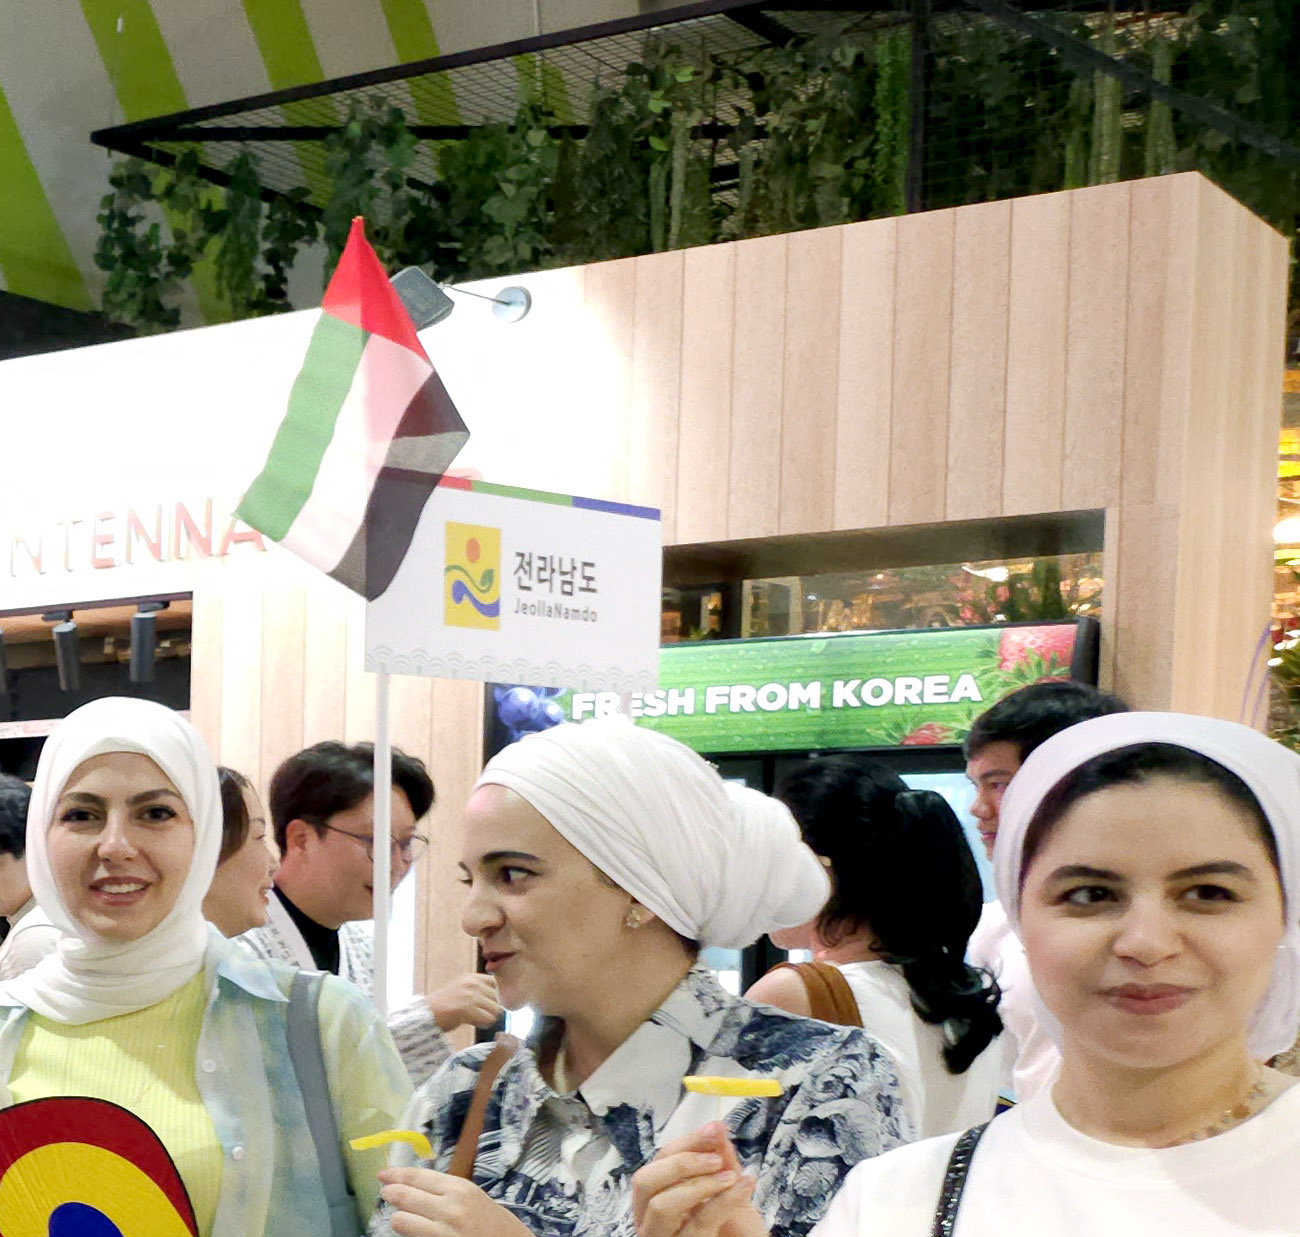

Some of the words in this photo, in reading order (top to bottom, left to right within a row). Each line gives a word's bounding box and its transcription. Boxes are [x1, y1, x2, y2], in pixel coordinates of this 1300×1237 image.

[513, 551, 598, 597] 전라남도
[514, 598, 598, 622] JeollaNamdo
[705, 681, 822, 714] FROM
[832, 673, 983, 709] KOREA
